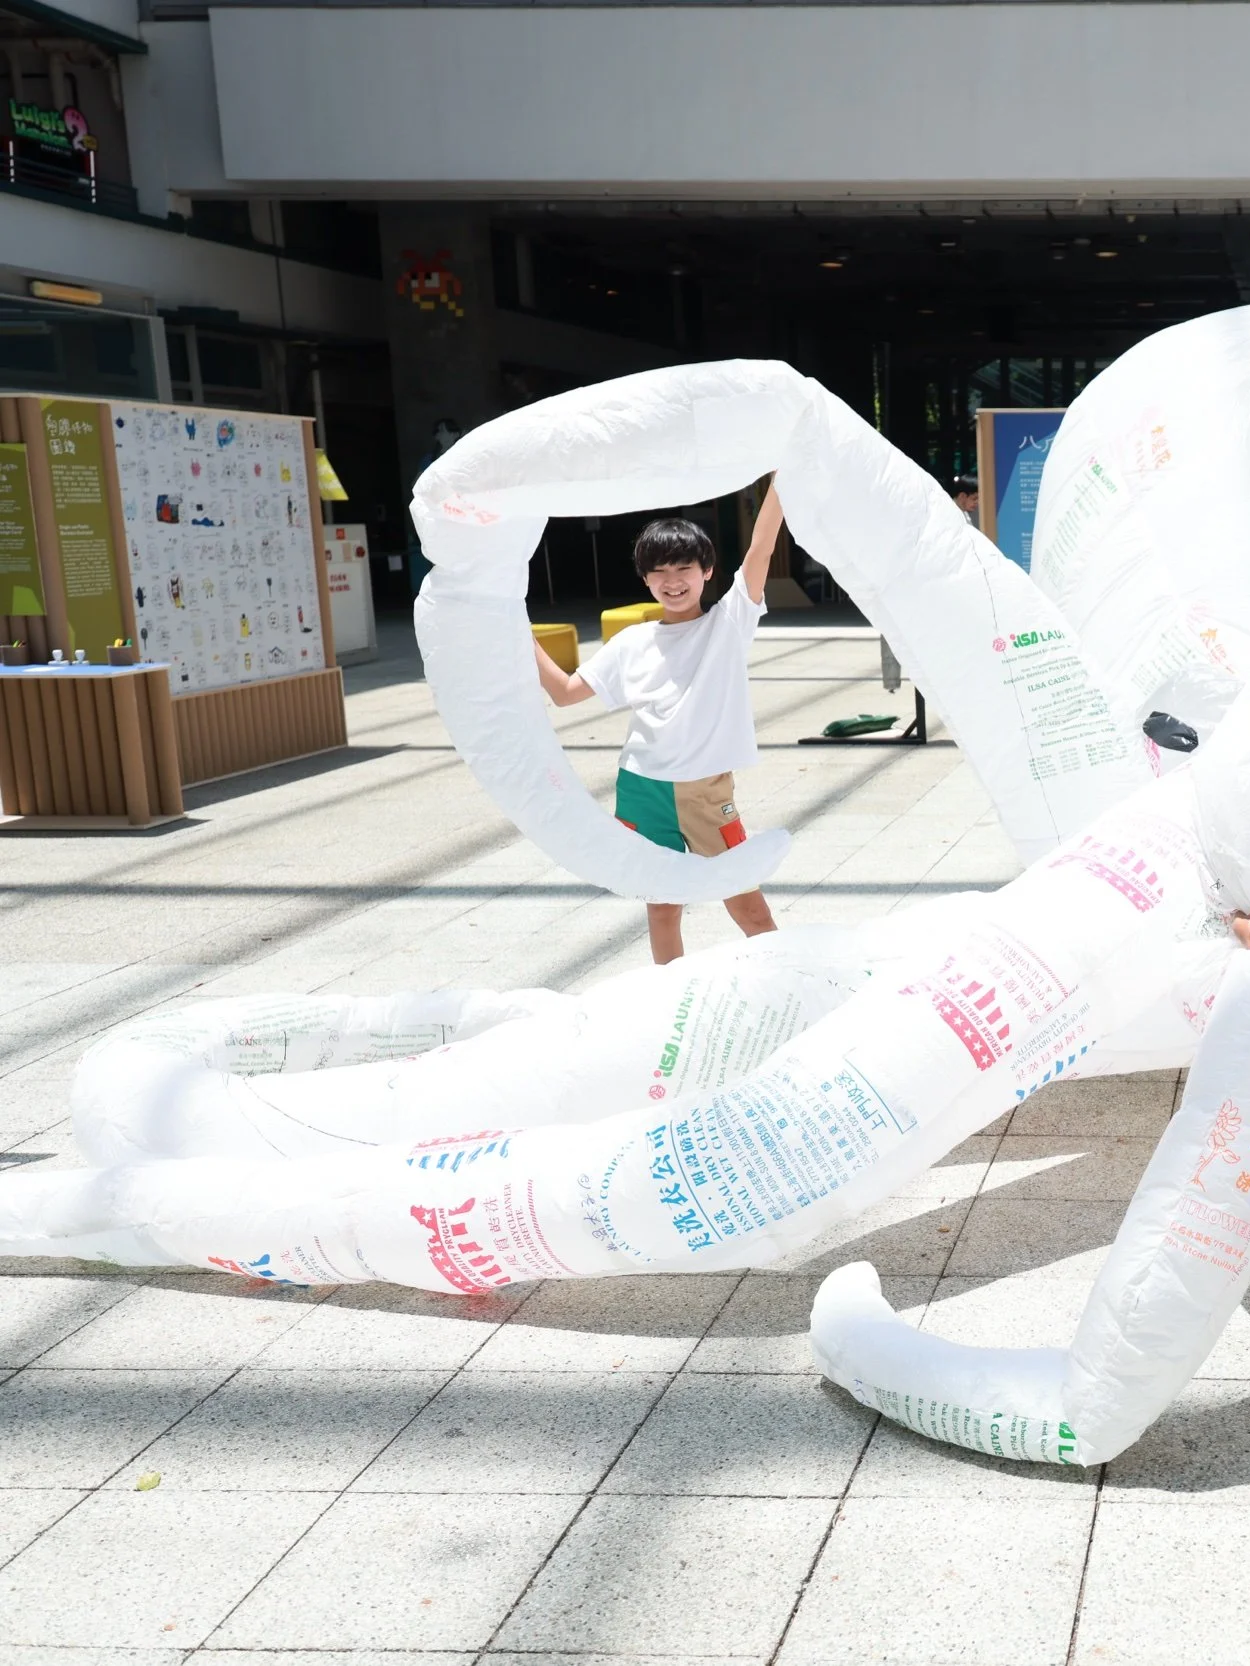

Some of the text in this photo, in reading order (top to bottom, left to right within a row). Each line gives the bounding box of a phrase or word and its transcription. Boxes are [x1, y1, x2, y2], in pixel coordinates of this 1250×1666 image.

[691, 1108, 708, 1151] CLEAN
[842, 1107, 859, 1129] 0244
[803, 1116, 834, 1155] MON-SUN
[703, 1156, 722, 1181] DRY
[718, 1157, 739, 1184] WET
[794, 1148, 810, 1166] 8547
[753, 1155, 780, 1193] MON-SUN
[806, 1165, 820, 1185] 2770
[438, 1208, 455, 1249] DRYCLEAN
[504, 1184, 524, 1248] DRYCLEANER
[1180, 1243, 1210, 1262] Stone
